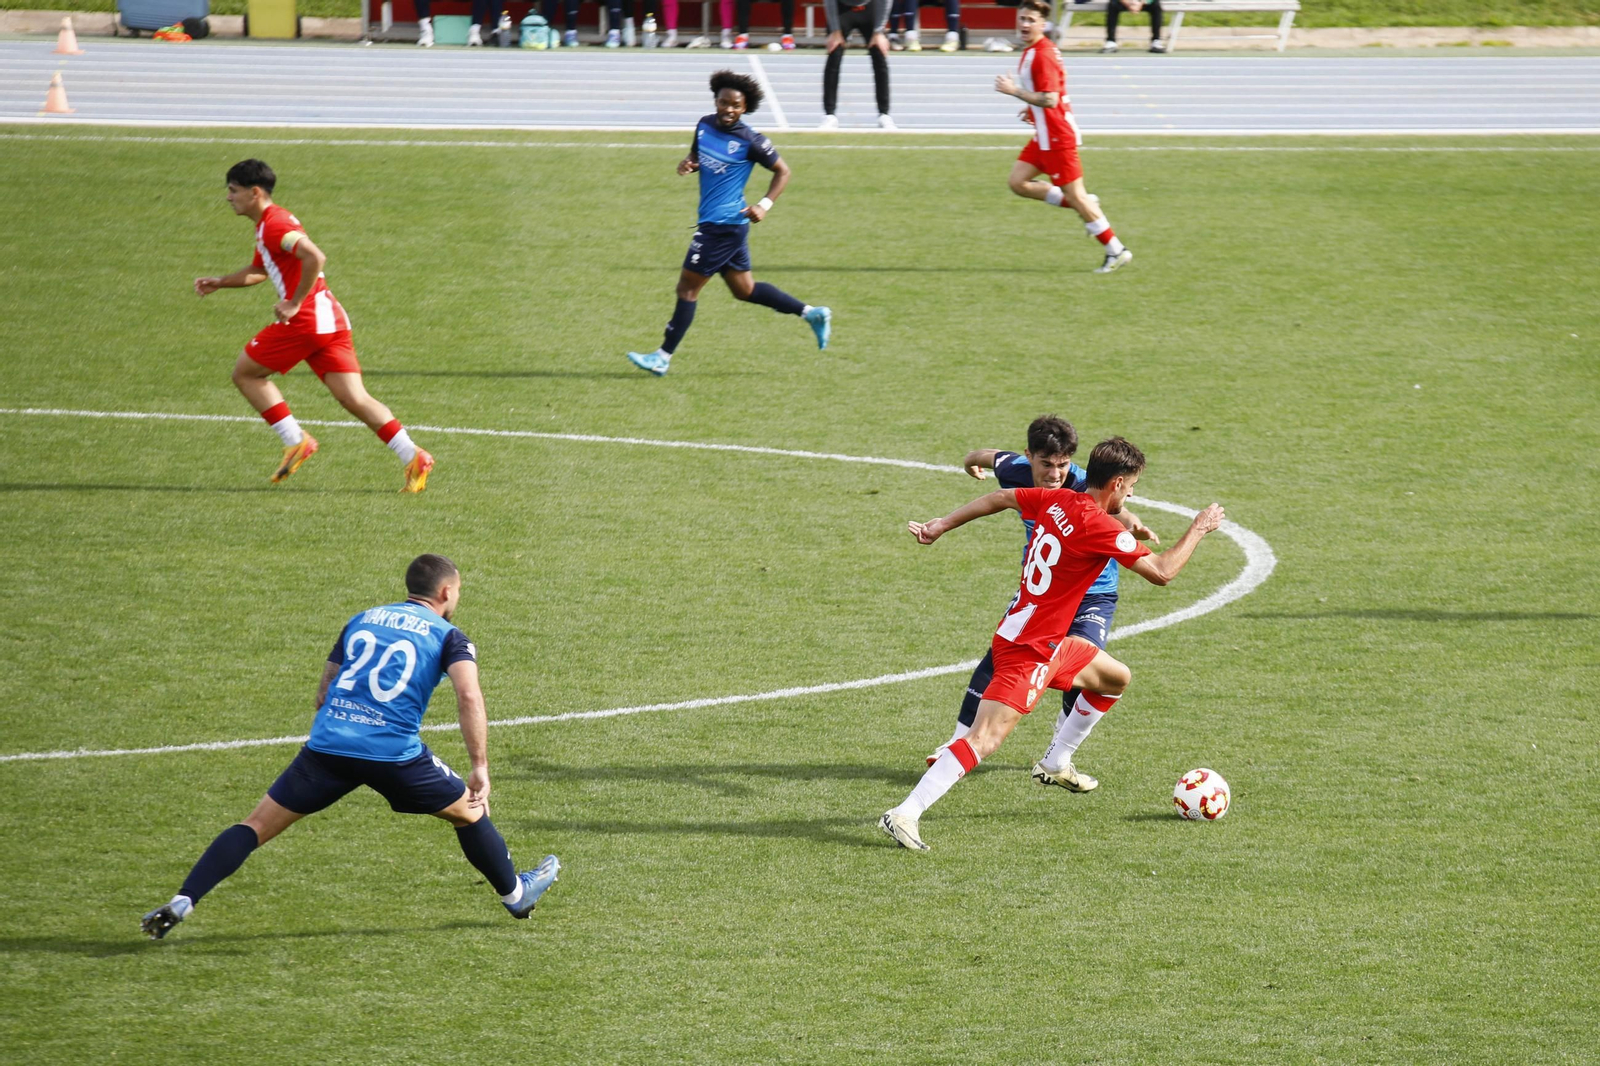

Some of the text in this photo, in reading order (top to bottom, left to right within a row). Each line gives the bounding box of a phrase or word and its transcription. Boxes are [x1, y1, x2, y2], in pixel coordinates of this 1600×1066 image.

[1022, 523, 1062, 596] 18
[385, 611, 434, 636] ROBLES
[335, 629, 417, 702] 20
[1029, 662, 1049, 690] 18
